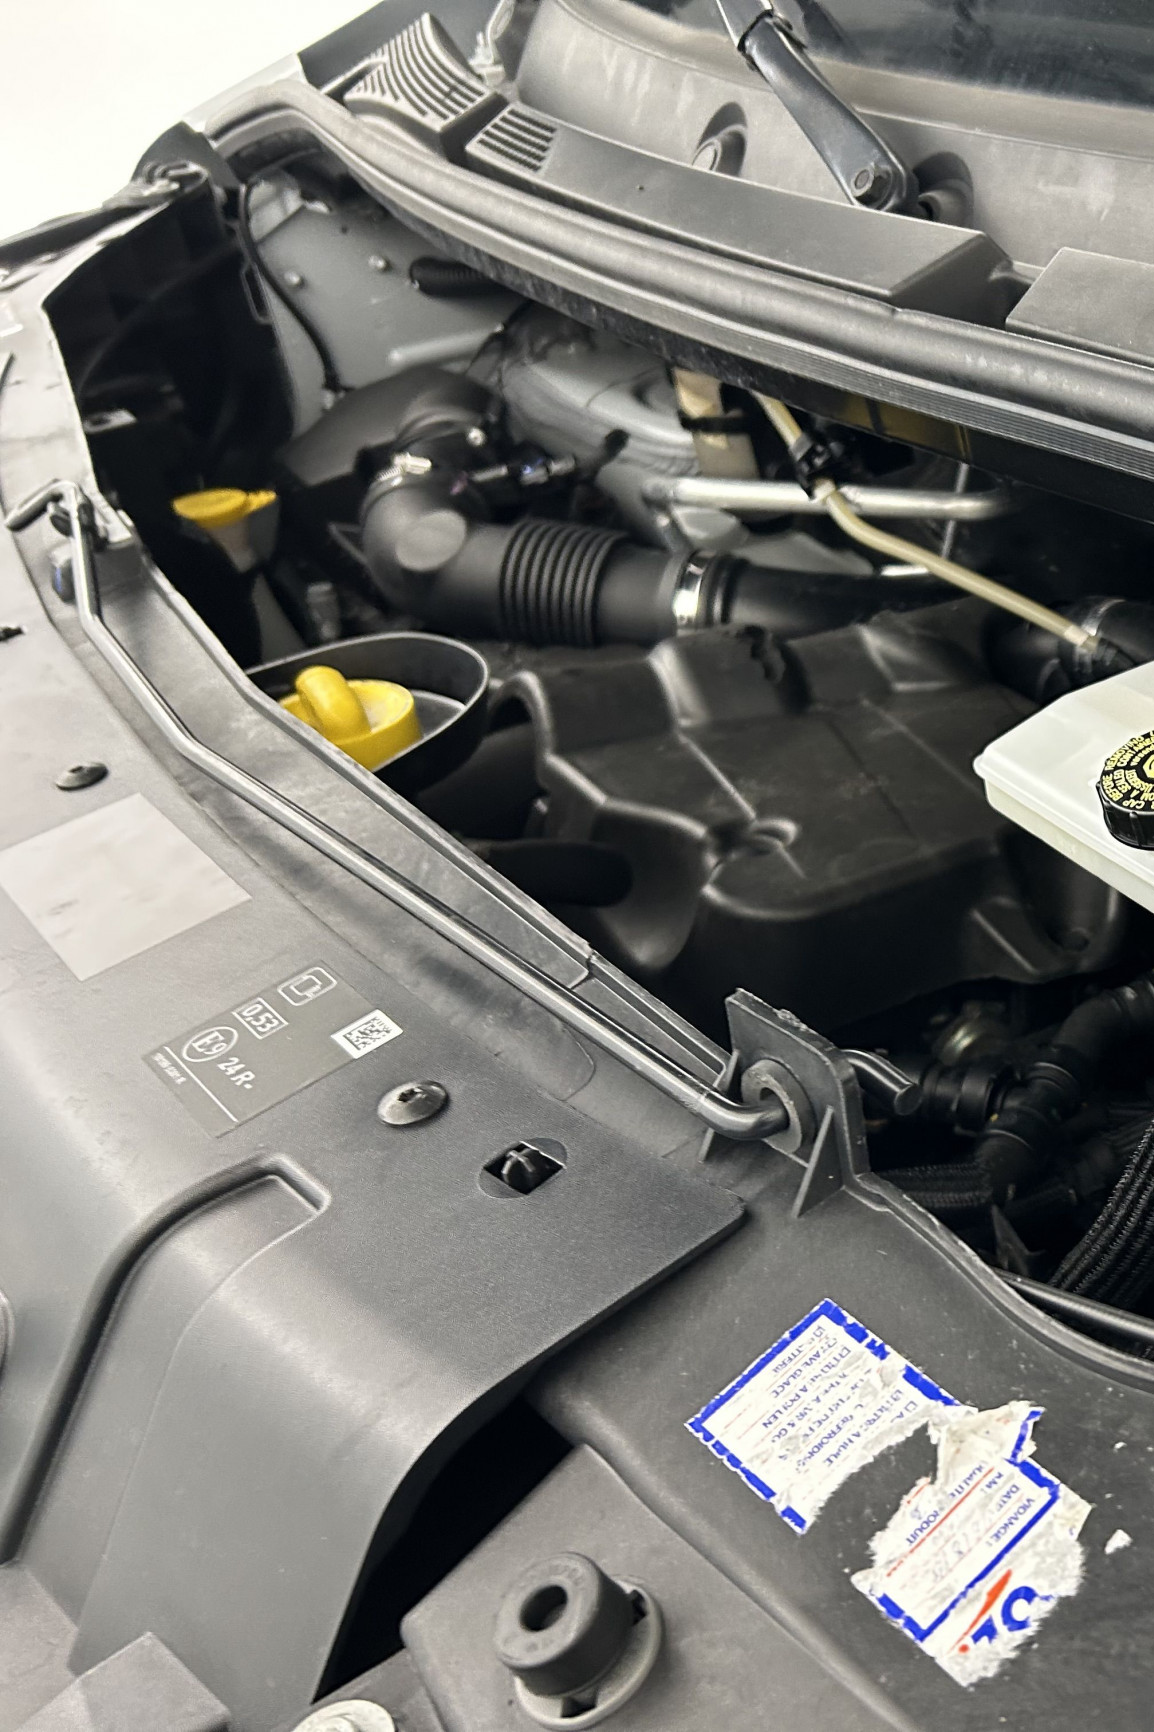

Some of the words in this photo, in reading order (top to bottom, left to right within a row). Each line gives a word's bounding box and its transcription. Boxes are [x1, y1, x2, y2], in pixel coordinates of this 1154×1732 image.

[1105, 734, 1145, 770] REMOVING
[1102, 772, 1124, 802] BEFORE
[1130, 788, 1140, 798] A
[1122, 798, 1146, 810] CAP
[242, 1003, 280, 1033] 0,53
[191, 1030, 228, 1055] E9
